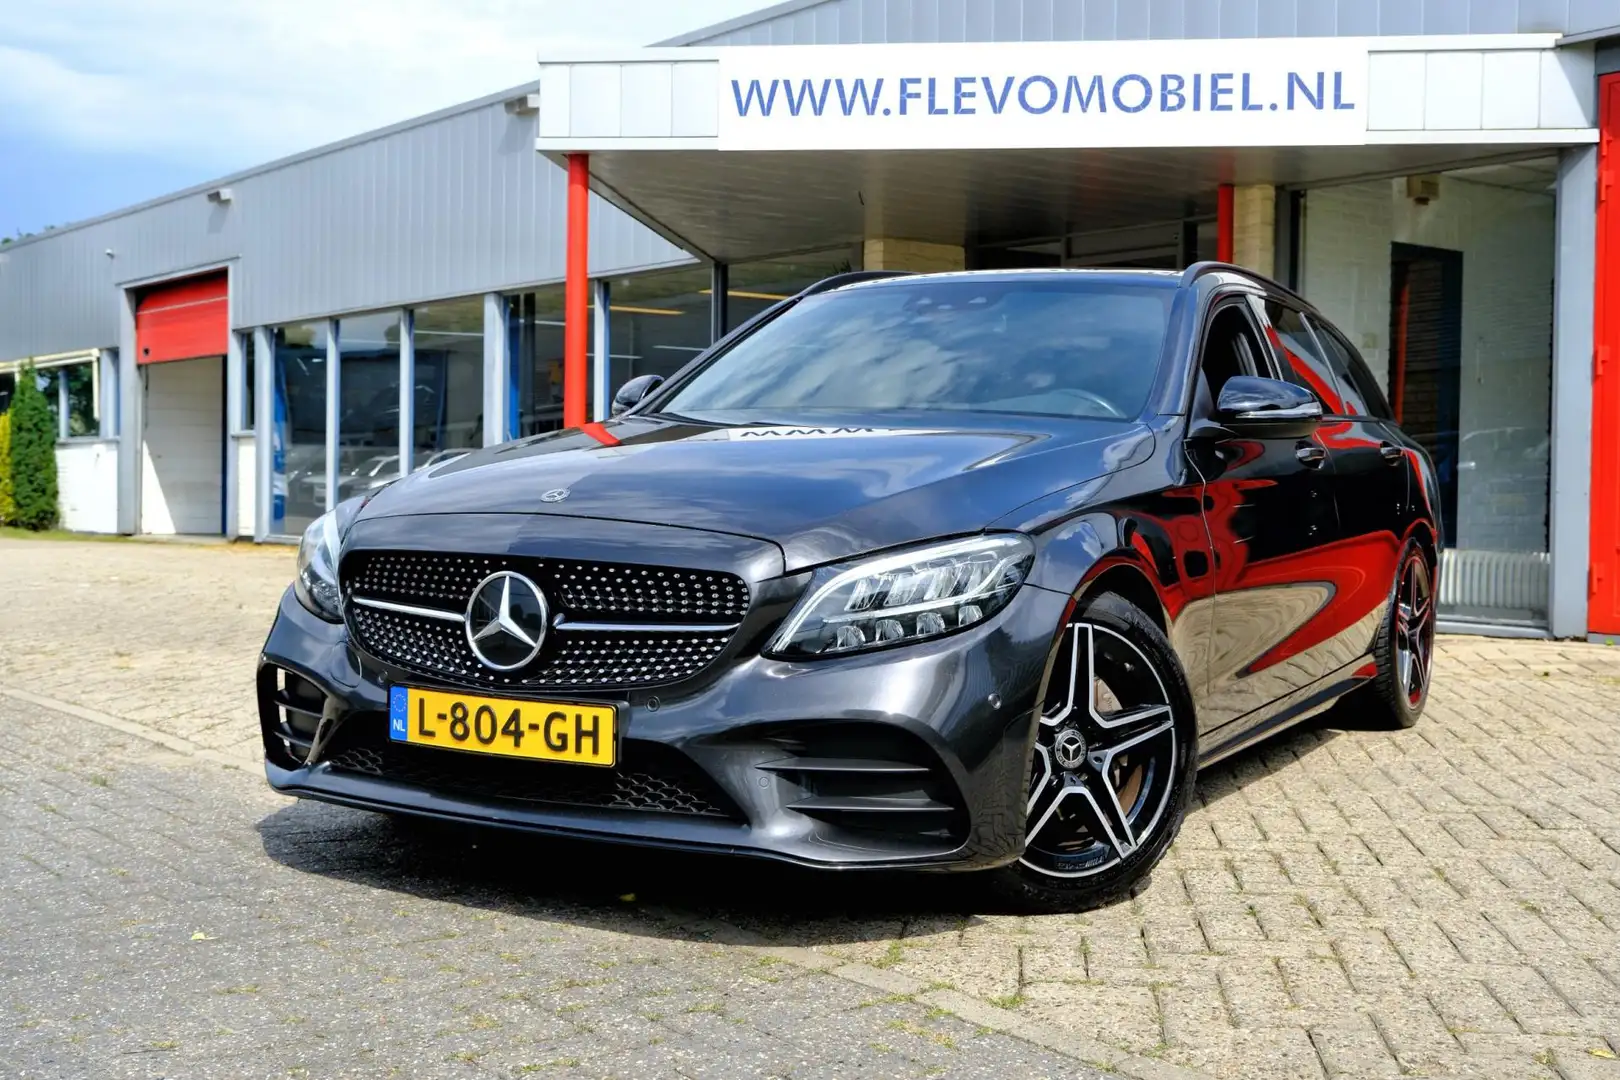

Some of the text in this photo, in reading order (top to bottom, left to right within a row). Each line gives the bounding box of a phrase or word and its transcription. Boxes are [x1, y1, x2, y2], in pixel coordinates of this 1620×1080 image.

[731, 71, 1354, 116] WWW.FLEVOMOBIEL.NL
[393, 718, 406, 732] NL
[418, 697, 600, 756] L-804-GH
